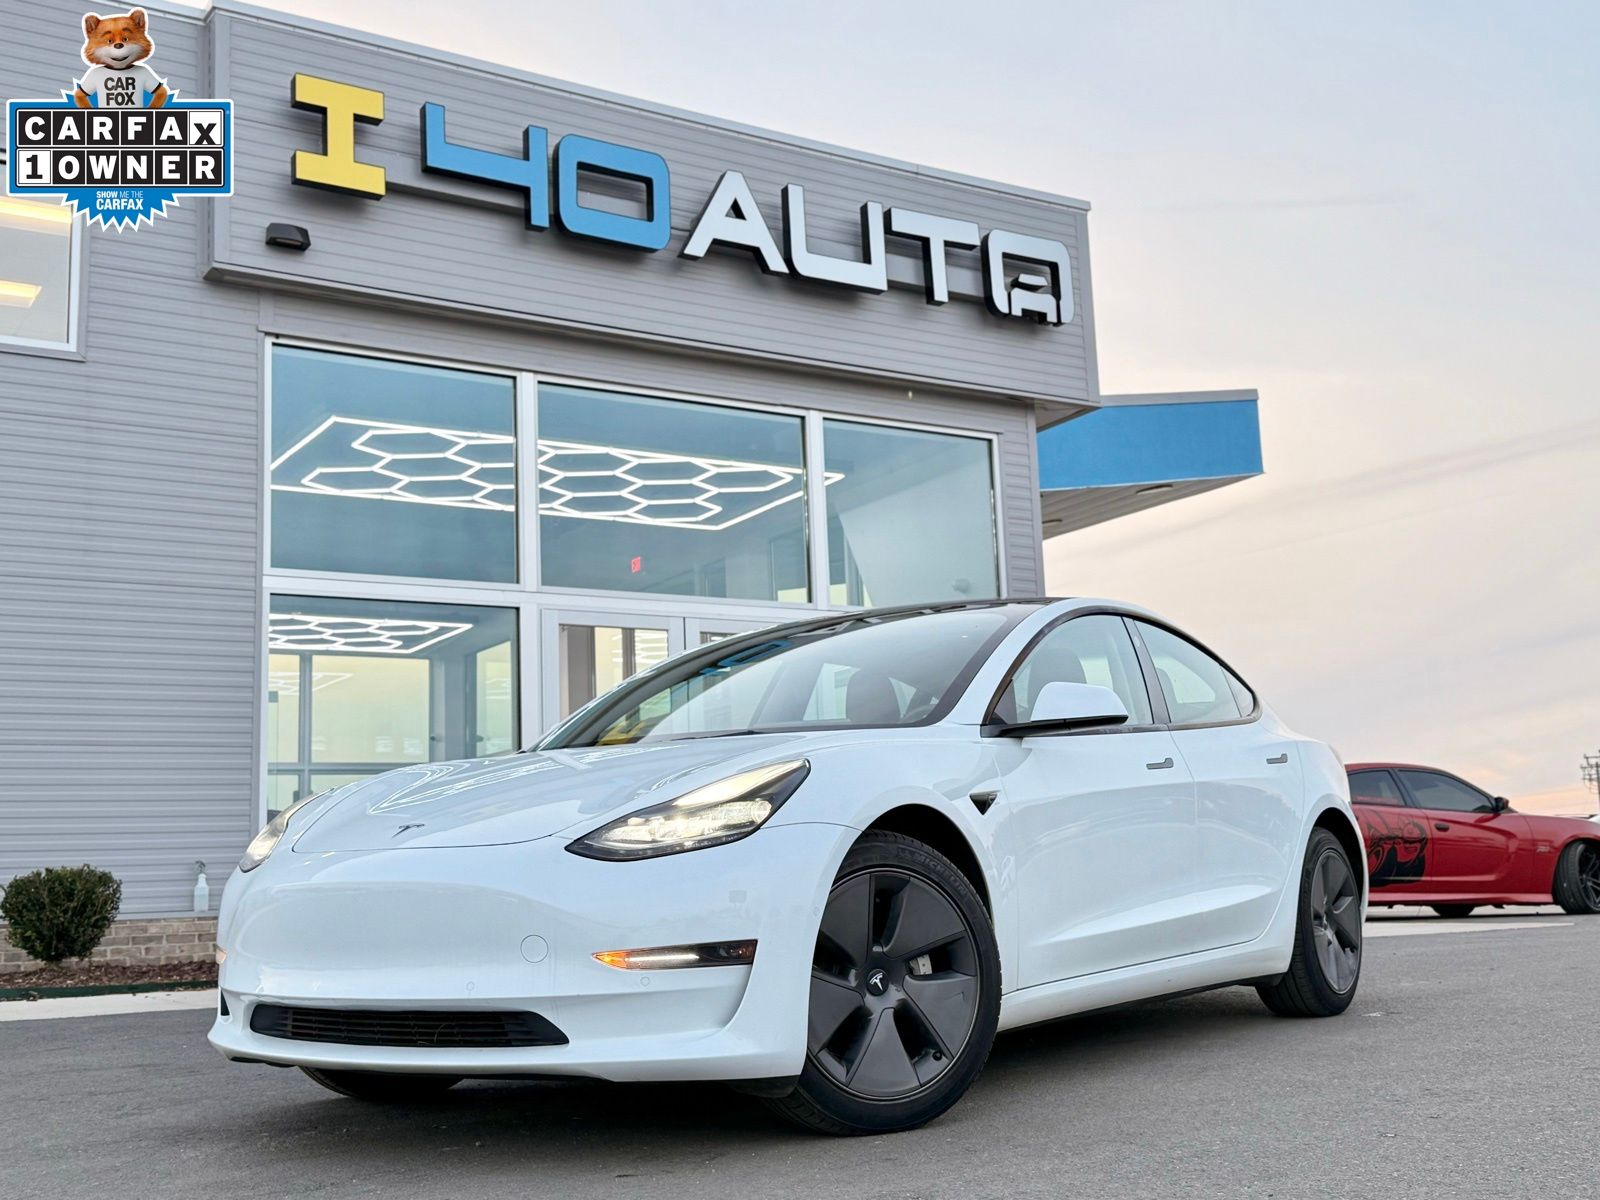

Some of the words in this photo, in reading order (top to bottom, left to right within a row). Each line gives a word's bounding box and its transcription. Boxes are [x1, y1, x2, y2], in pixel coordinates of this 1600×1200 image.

[291, 73, 386, 200] I
[421, 101, 671, 252] 40
[678, 169, 1075, 327] AUTO
